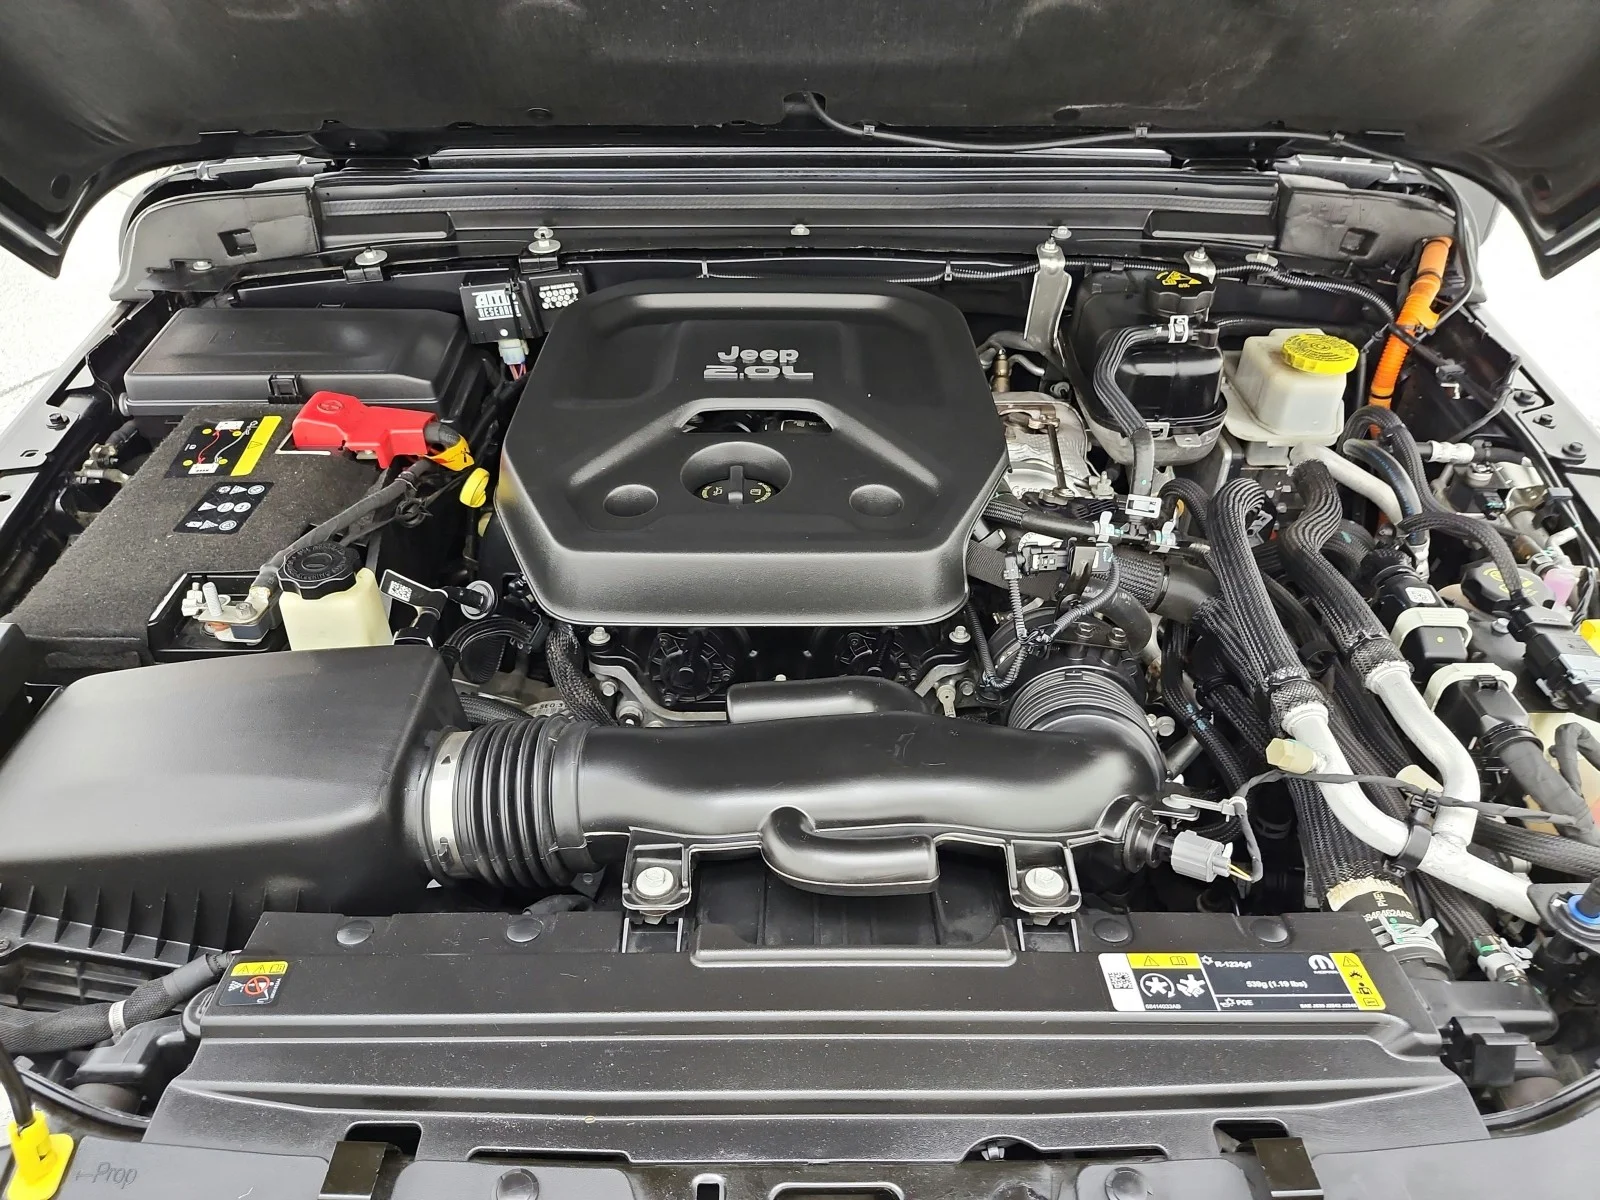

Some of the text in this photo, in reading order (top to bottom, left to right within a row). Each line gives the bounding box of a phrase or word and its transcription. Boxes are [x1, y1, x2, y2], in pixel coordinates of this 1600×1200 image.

[717, 345, 799, 364] Jeep
[703, 365, 814, 380] 2.0L
[1214, 960, 1252, 970] R-1234yf
[1268, 980, 1289, 989] (1.19
[1290, 980, 1308, 989] lbs)
[92, 1161, 138, 1190] Prop
